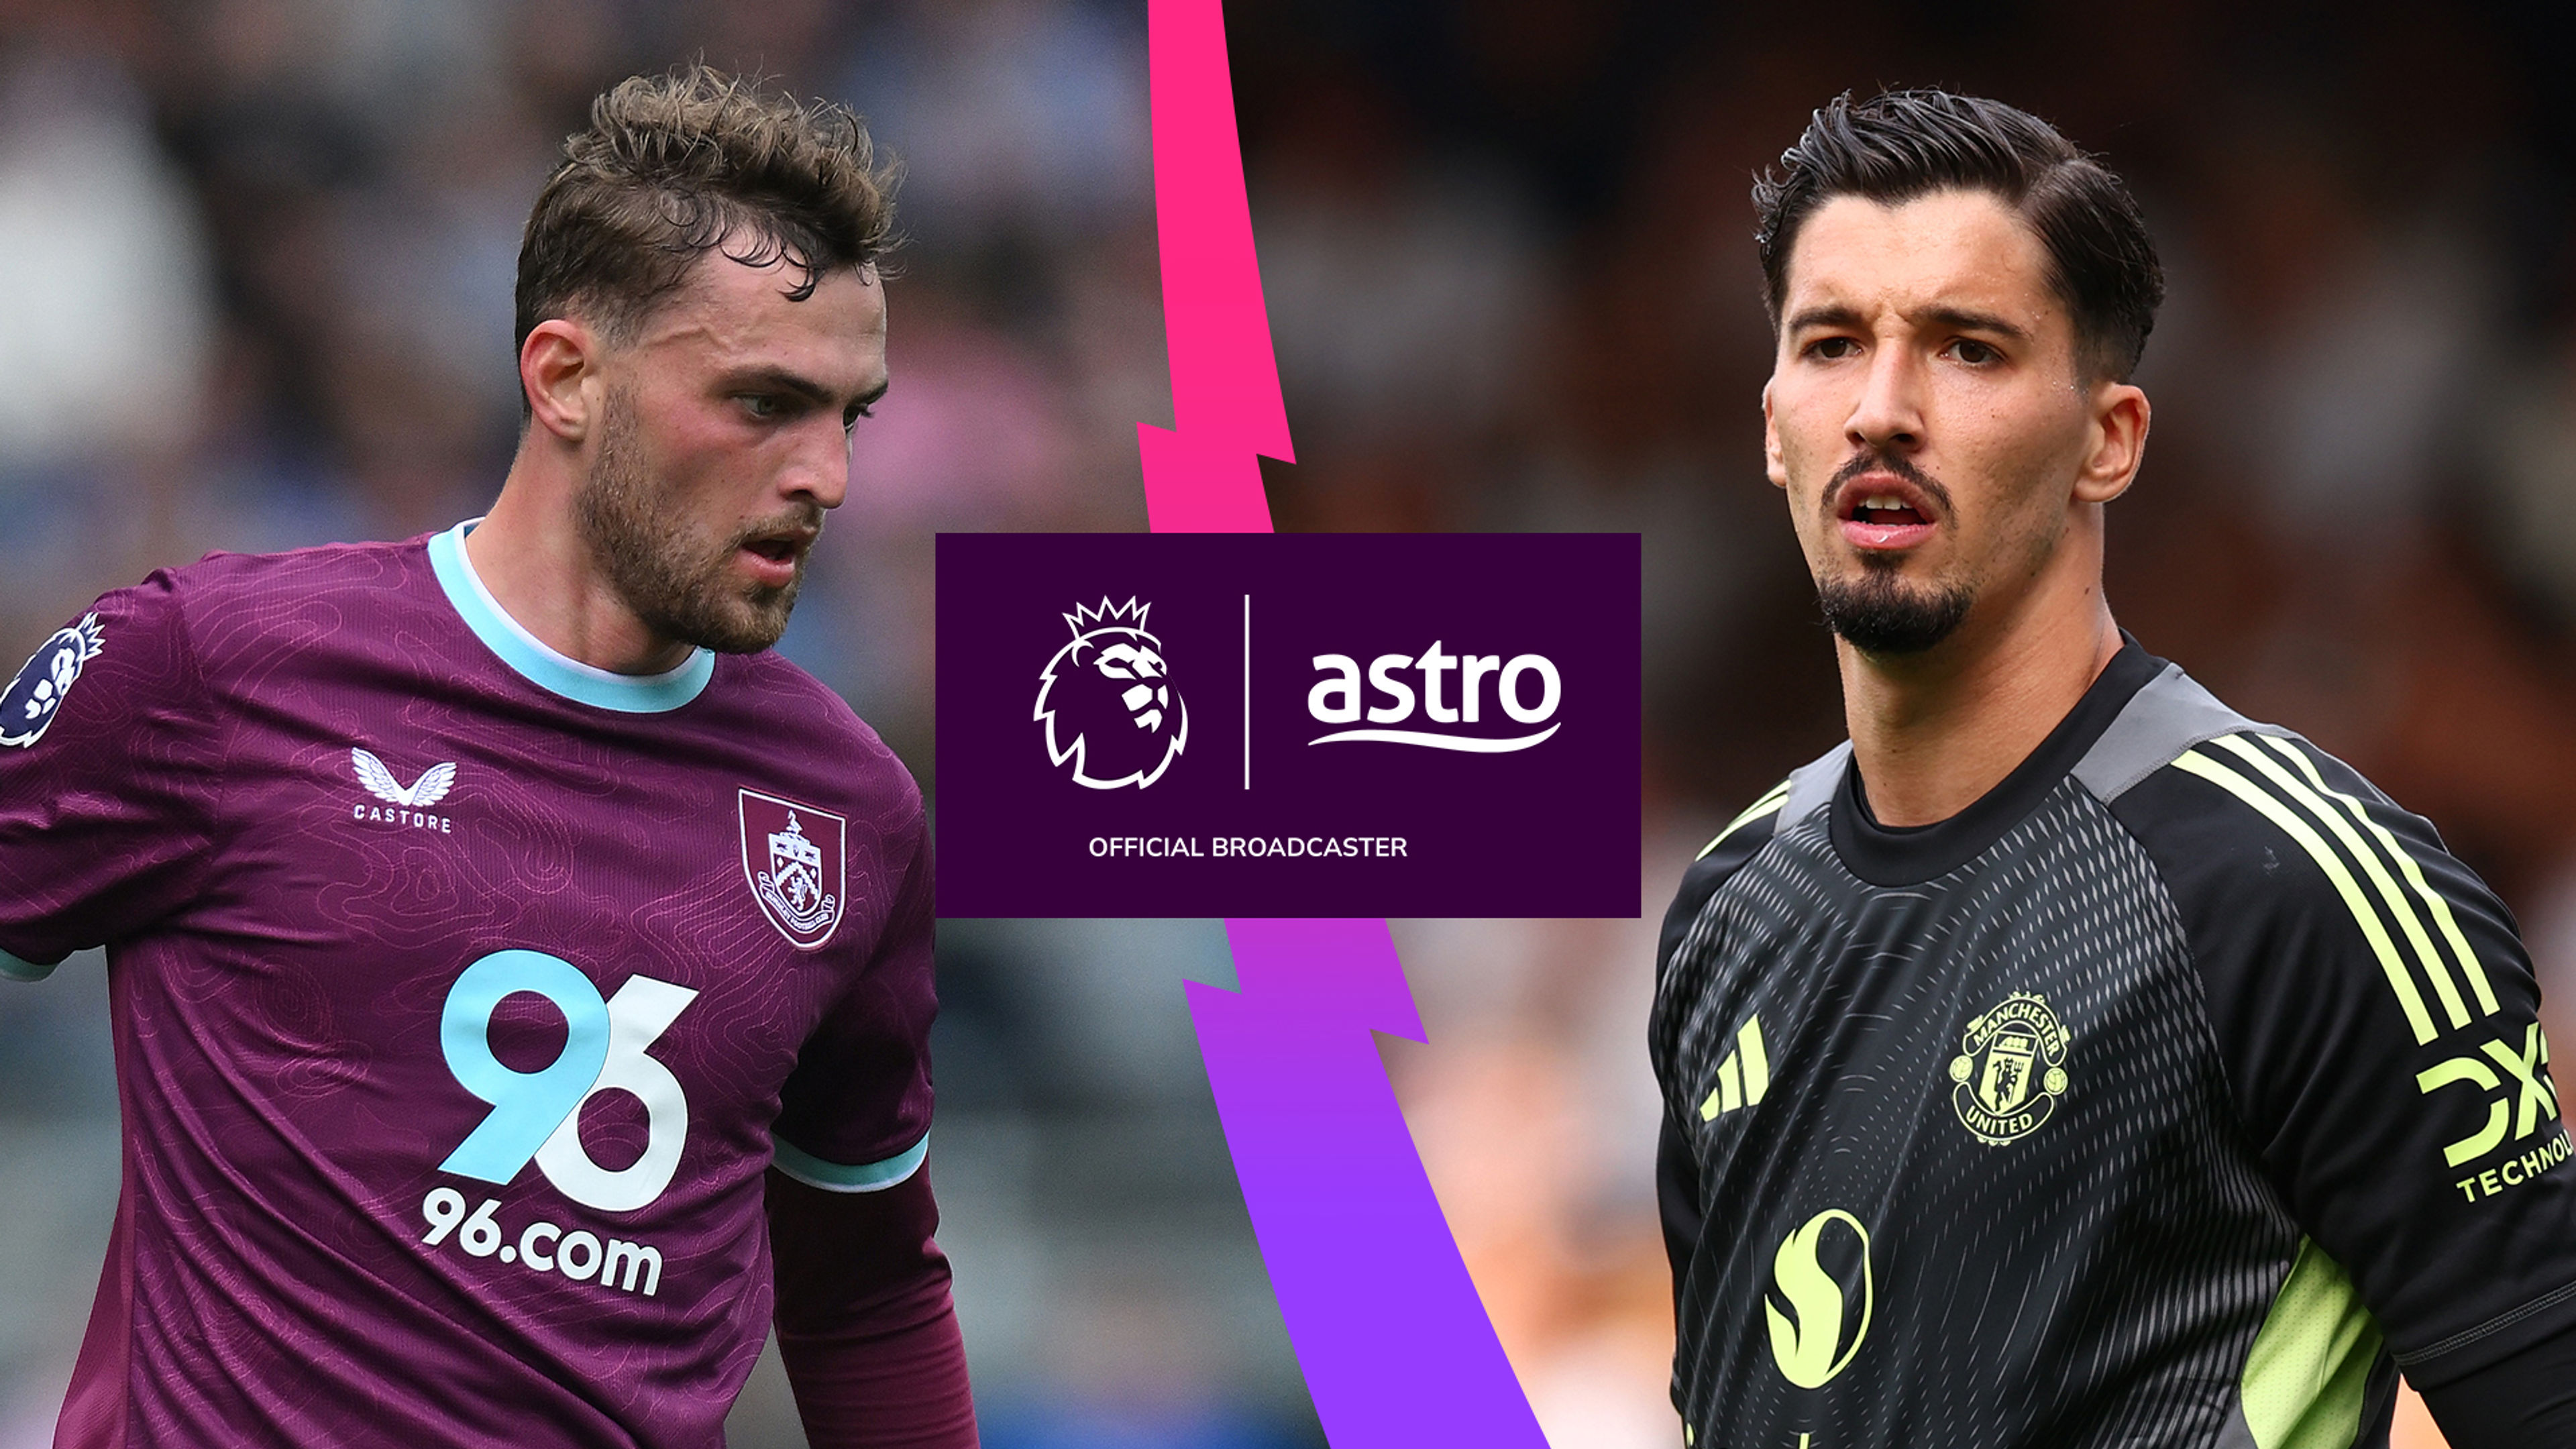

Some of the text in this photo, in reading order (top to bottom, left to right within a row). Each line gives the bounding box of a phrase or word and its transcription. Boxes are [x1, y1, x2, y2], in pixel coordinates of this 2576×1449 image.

[354, 804, 451, 834] CASTORE
[1973, 1002, 2060, 1057] MANCHESTER
[437, 949, 700, 1212] 96
[1966, 1105, 2033, 1136] UNITED
[2455, 1128, 2574, 1203] TECHNOL
[421, 1187, 663, 1296] 96.com
